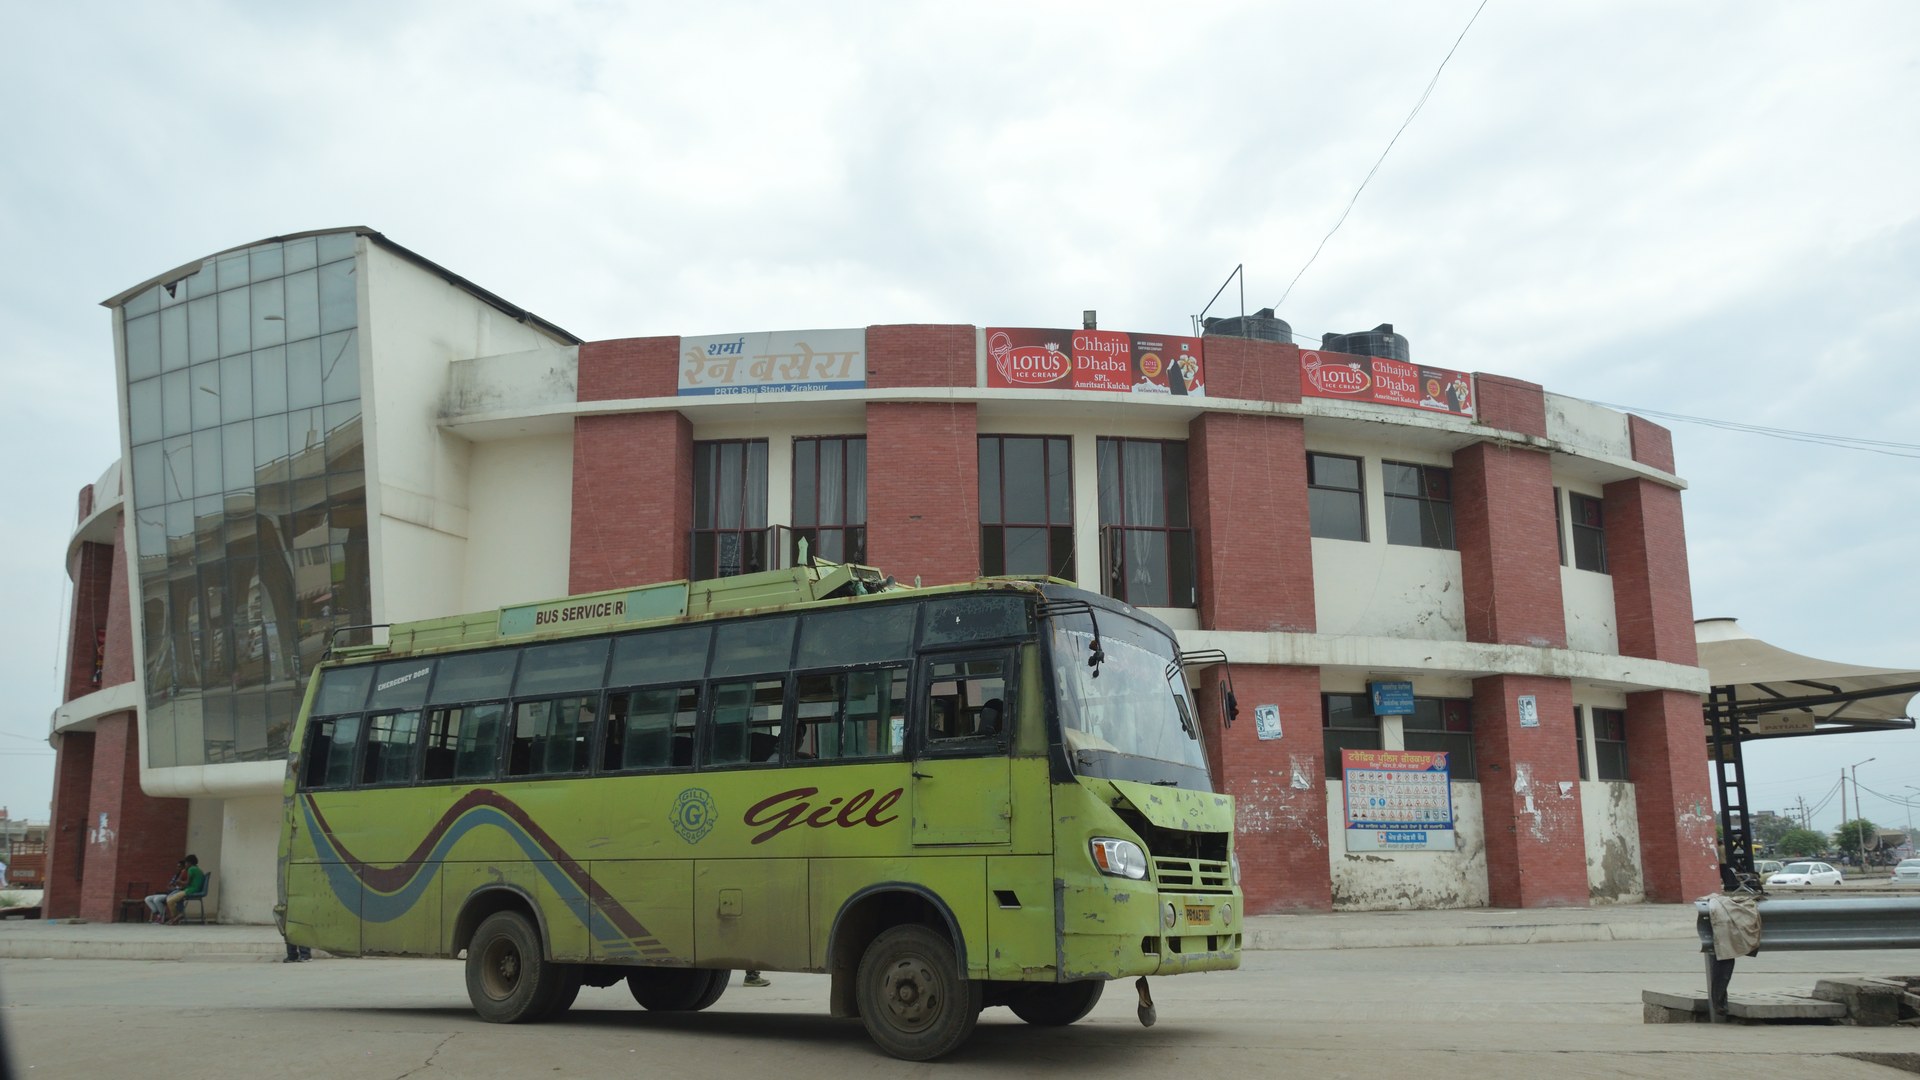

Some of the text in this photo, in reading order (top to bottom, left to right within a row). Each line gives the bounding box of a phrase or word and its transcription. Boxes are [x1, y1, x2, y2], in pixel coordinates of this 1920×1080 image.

[707, 337, 745, 356] शर्मा
[1073, 336, 1129, 356] Chhajju
[1013, 355, 1060, 370] LOTUS
[1077, 355, 1126, 372] Dhaba
[1372, 361, 1418, 378] Chhajju's
[1074, 380, 1130, 390] Amritsari Kulcha
[1094, 374, 1110, 382] SPL.
[1322, 370, 1362, 384] LOTUS
[1376, 375, 1416, 393] Dhaba
[714, 387, 739, 396] PRTC
[741, 386, 758, 394] Bus
[790, 384, 828, 393] Zirakpur
[536, 609, 559, 625] BUS
[377, 667, 430, 691] EMERGENCY DOOR
[682, 791, 705, 801] GILL
[685, 804, 704, 826] G
[743, 786, 904, 845] Gill
[681, 827, 706, 840] COACH
